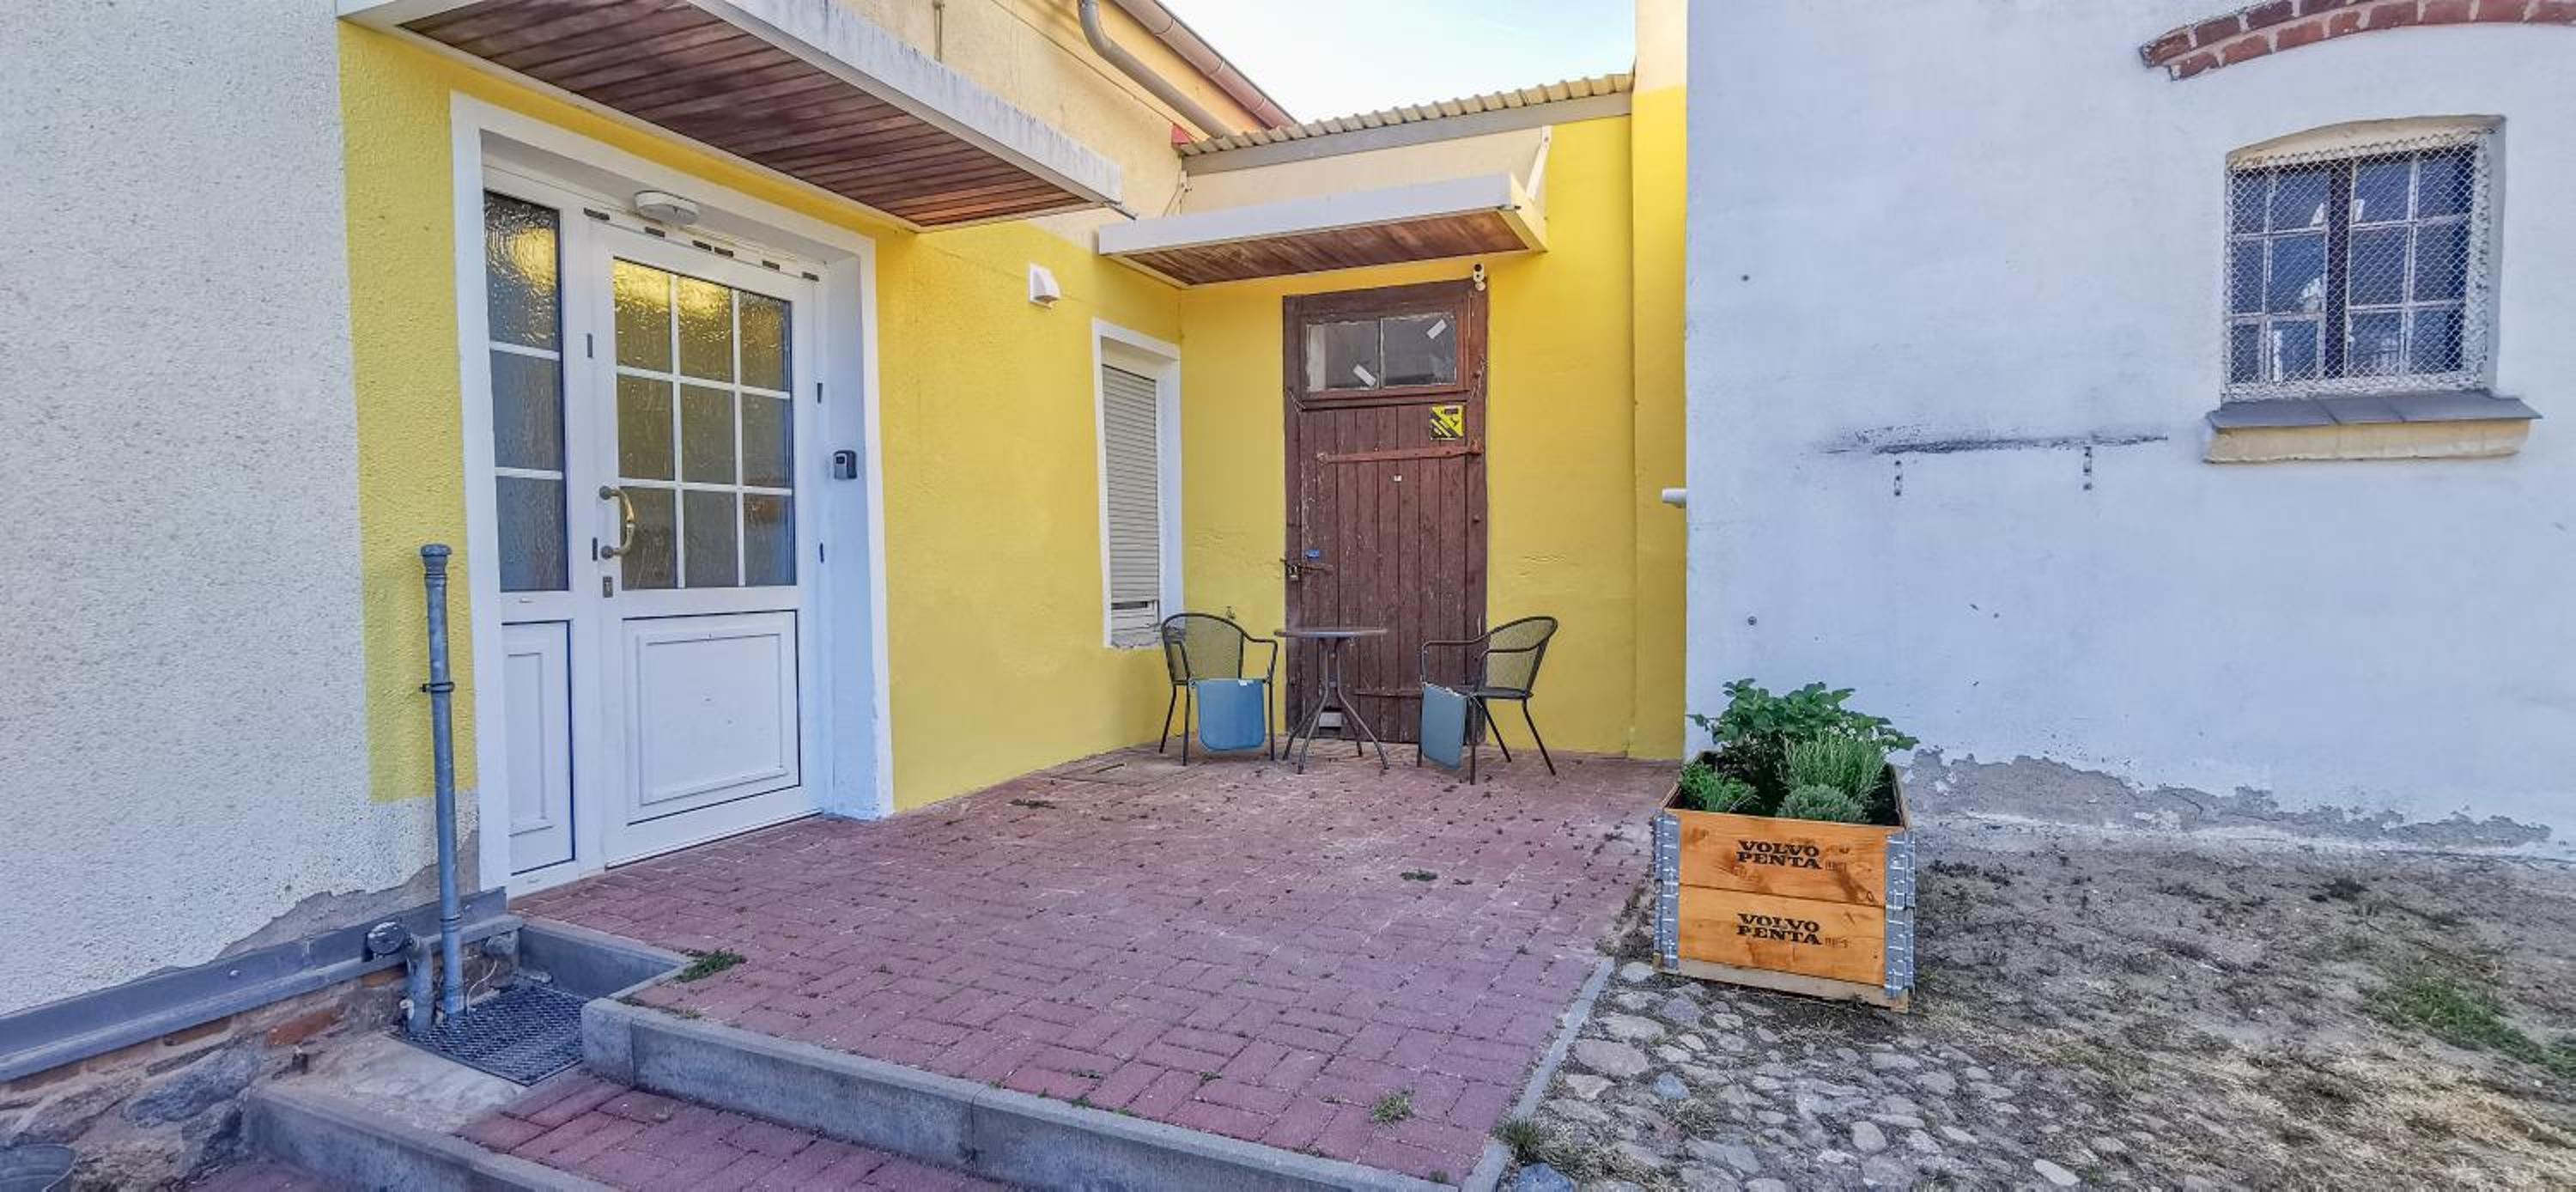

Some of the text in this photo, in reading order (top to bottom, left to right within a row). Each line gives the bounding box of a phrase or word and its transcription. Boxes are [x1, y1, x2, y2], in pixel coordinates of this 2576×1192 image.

[1737, 839, 1820, 857] VOLVO
[1736, 851, 1823, 869] PENTA
[1737, 913, 1820, 933] VOLVO
[1736, 925, 1822, 946] PENTA
